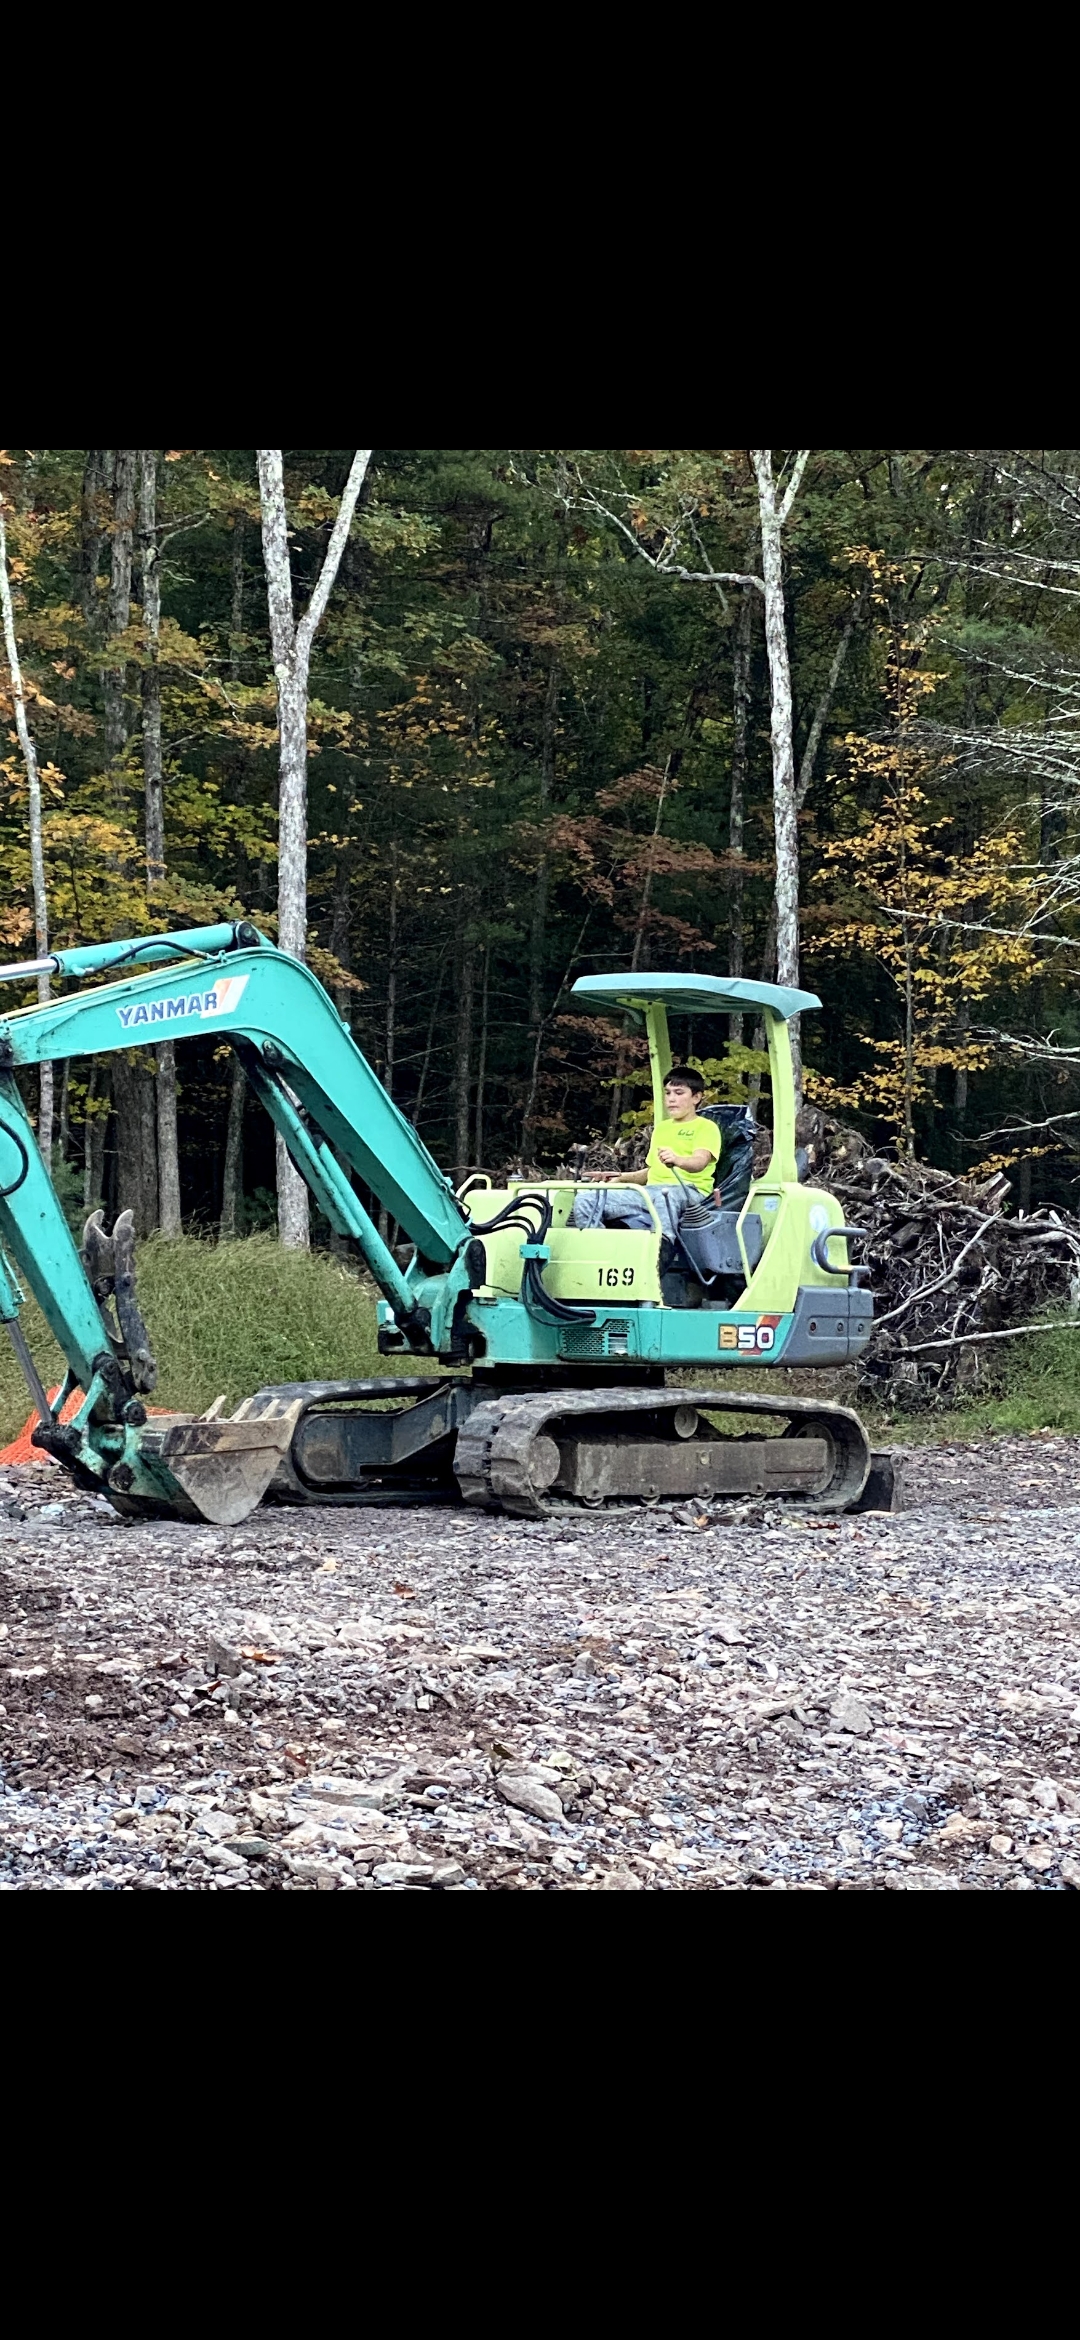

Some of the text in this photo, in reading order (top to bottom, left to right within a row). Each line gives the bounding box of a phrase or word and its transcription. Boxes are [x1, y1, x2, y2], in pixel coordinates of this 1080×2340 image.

[118, 992, 218, 1027] YANMAR
[597, 1267, 635, 1287] 169
[718, 1323, 775, 1350] B50
